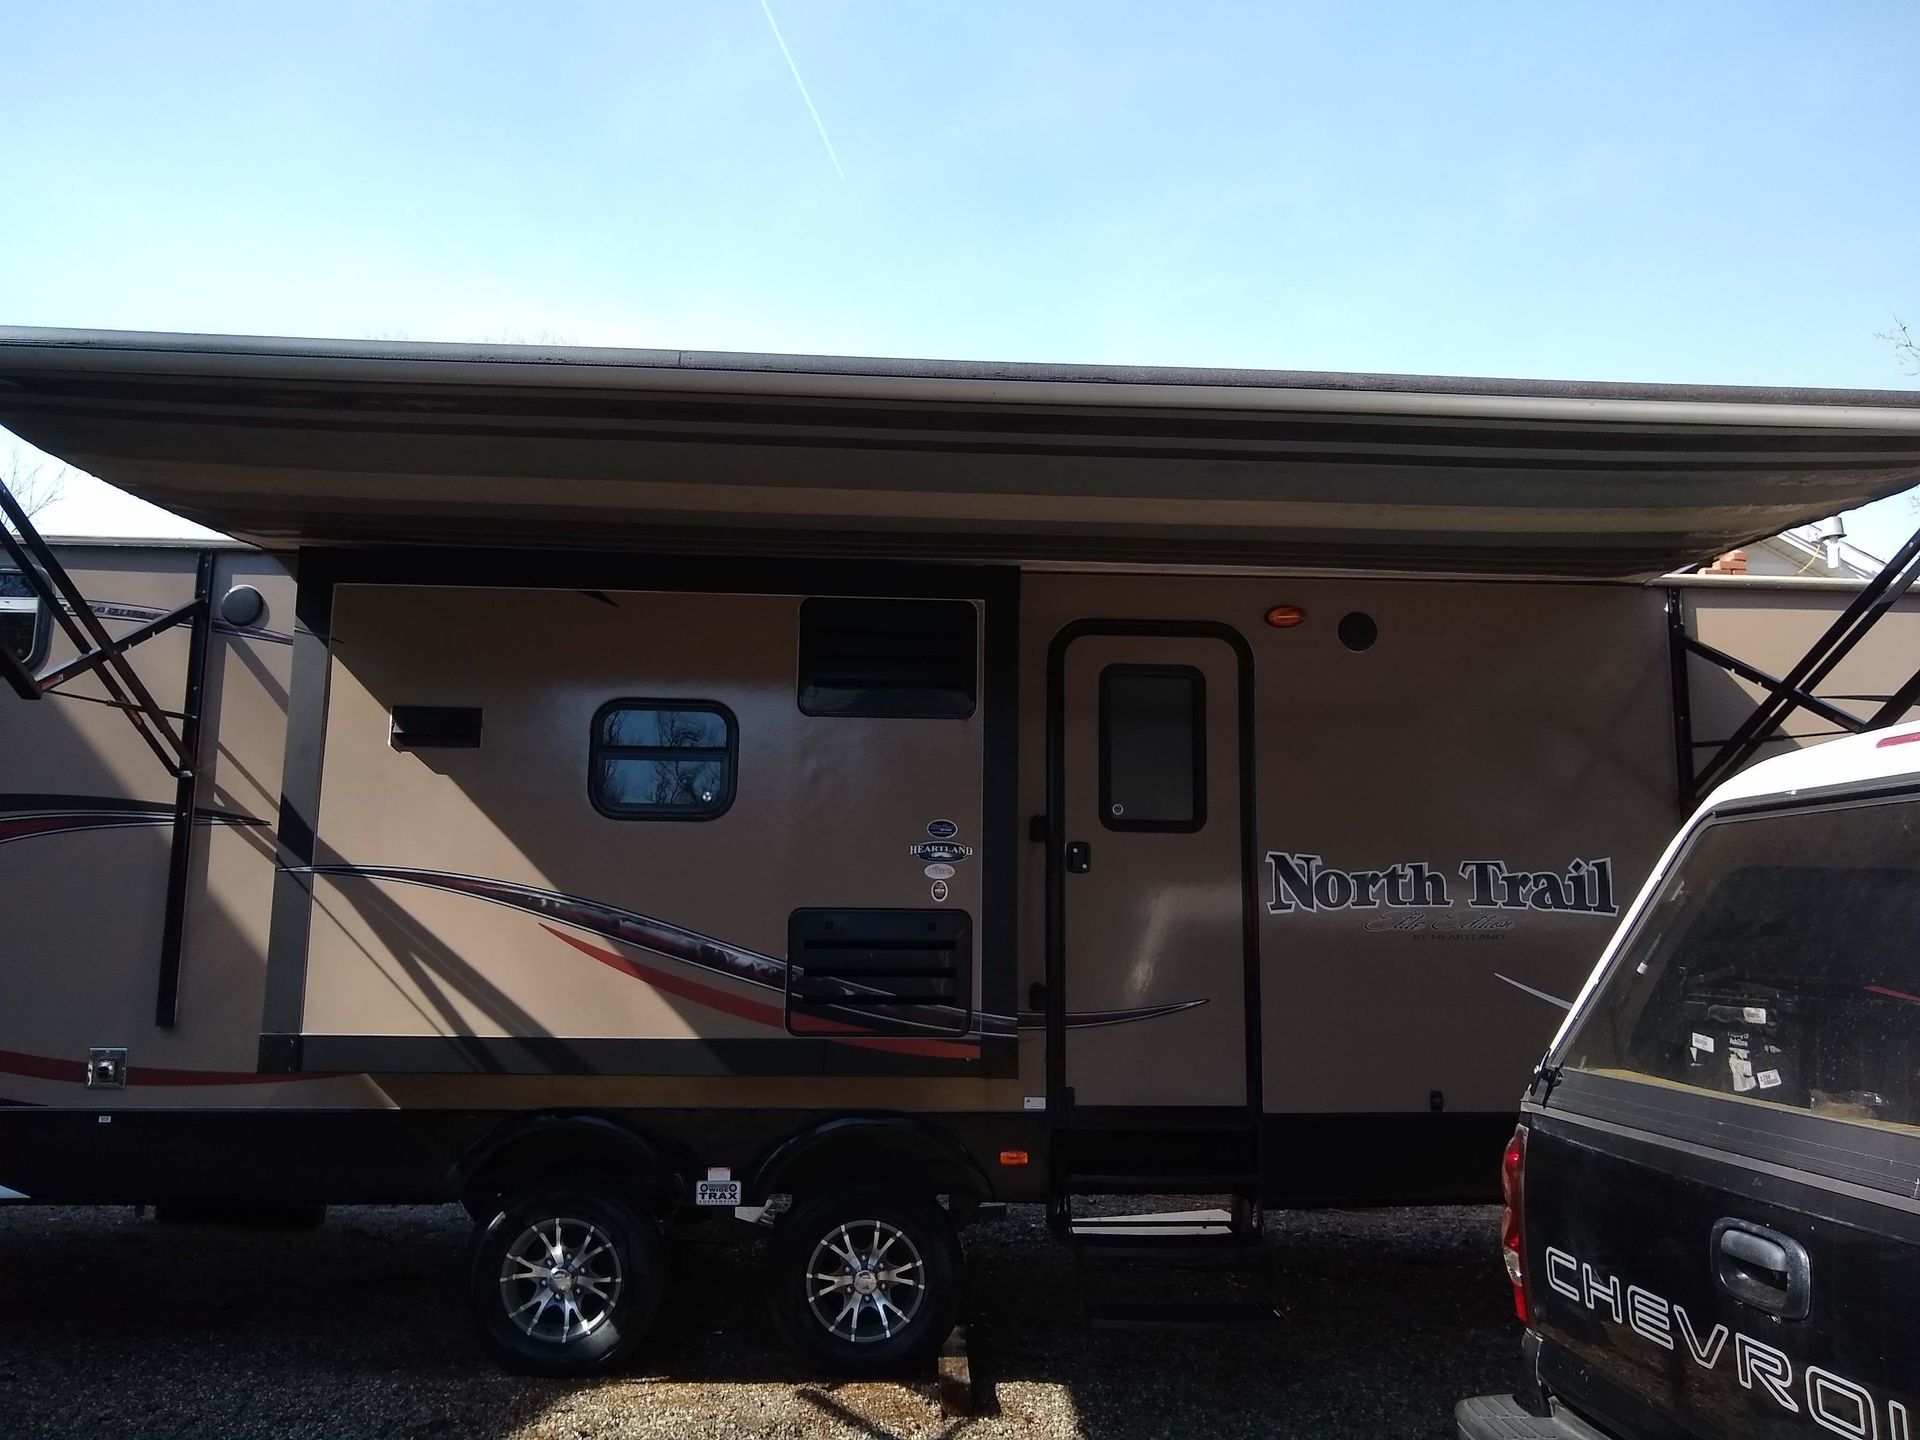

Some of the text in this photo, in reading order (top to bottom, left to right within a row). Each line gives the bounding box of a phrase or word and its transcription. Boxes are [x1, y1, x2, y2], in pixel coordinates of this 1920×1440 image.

[910, 845, 973, 856] HEARTLAND
[1265, 851, 1620, 917] North Trail
